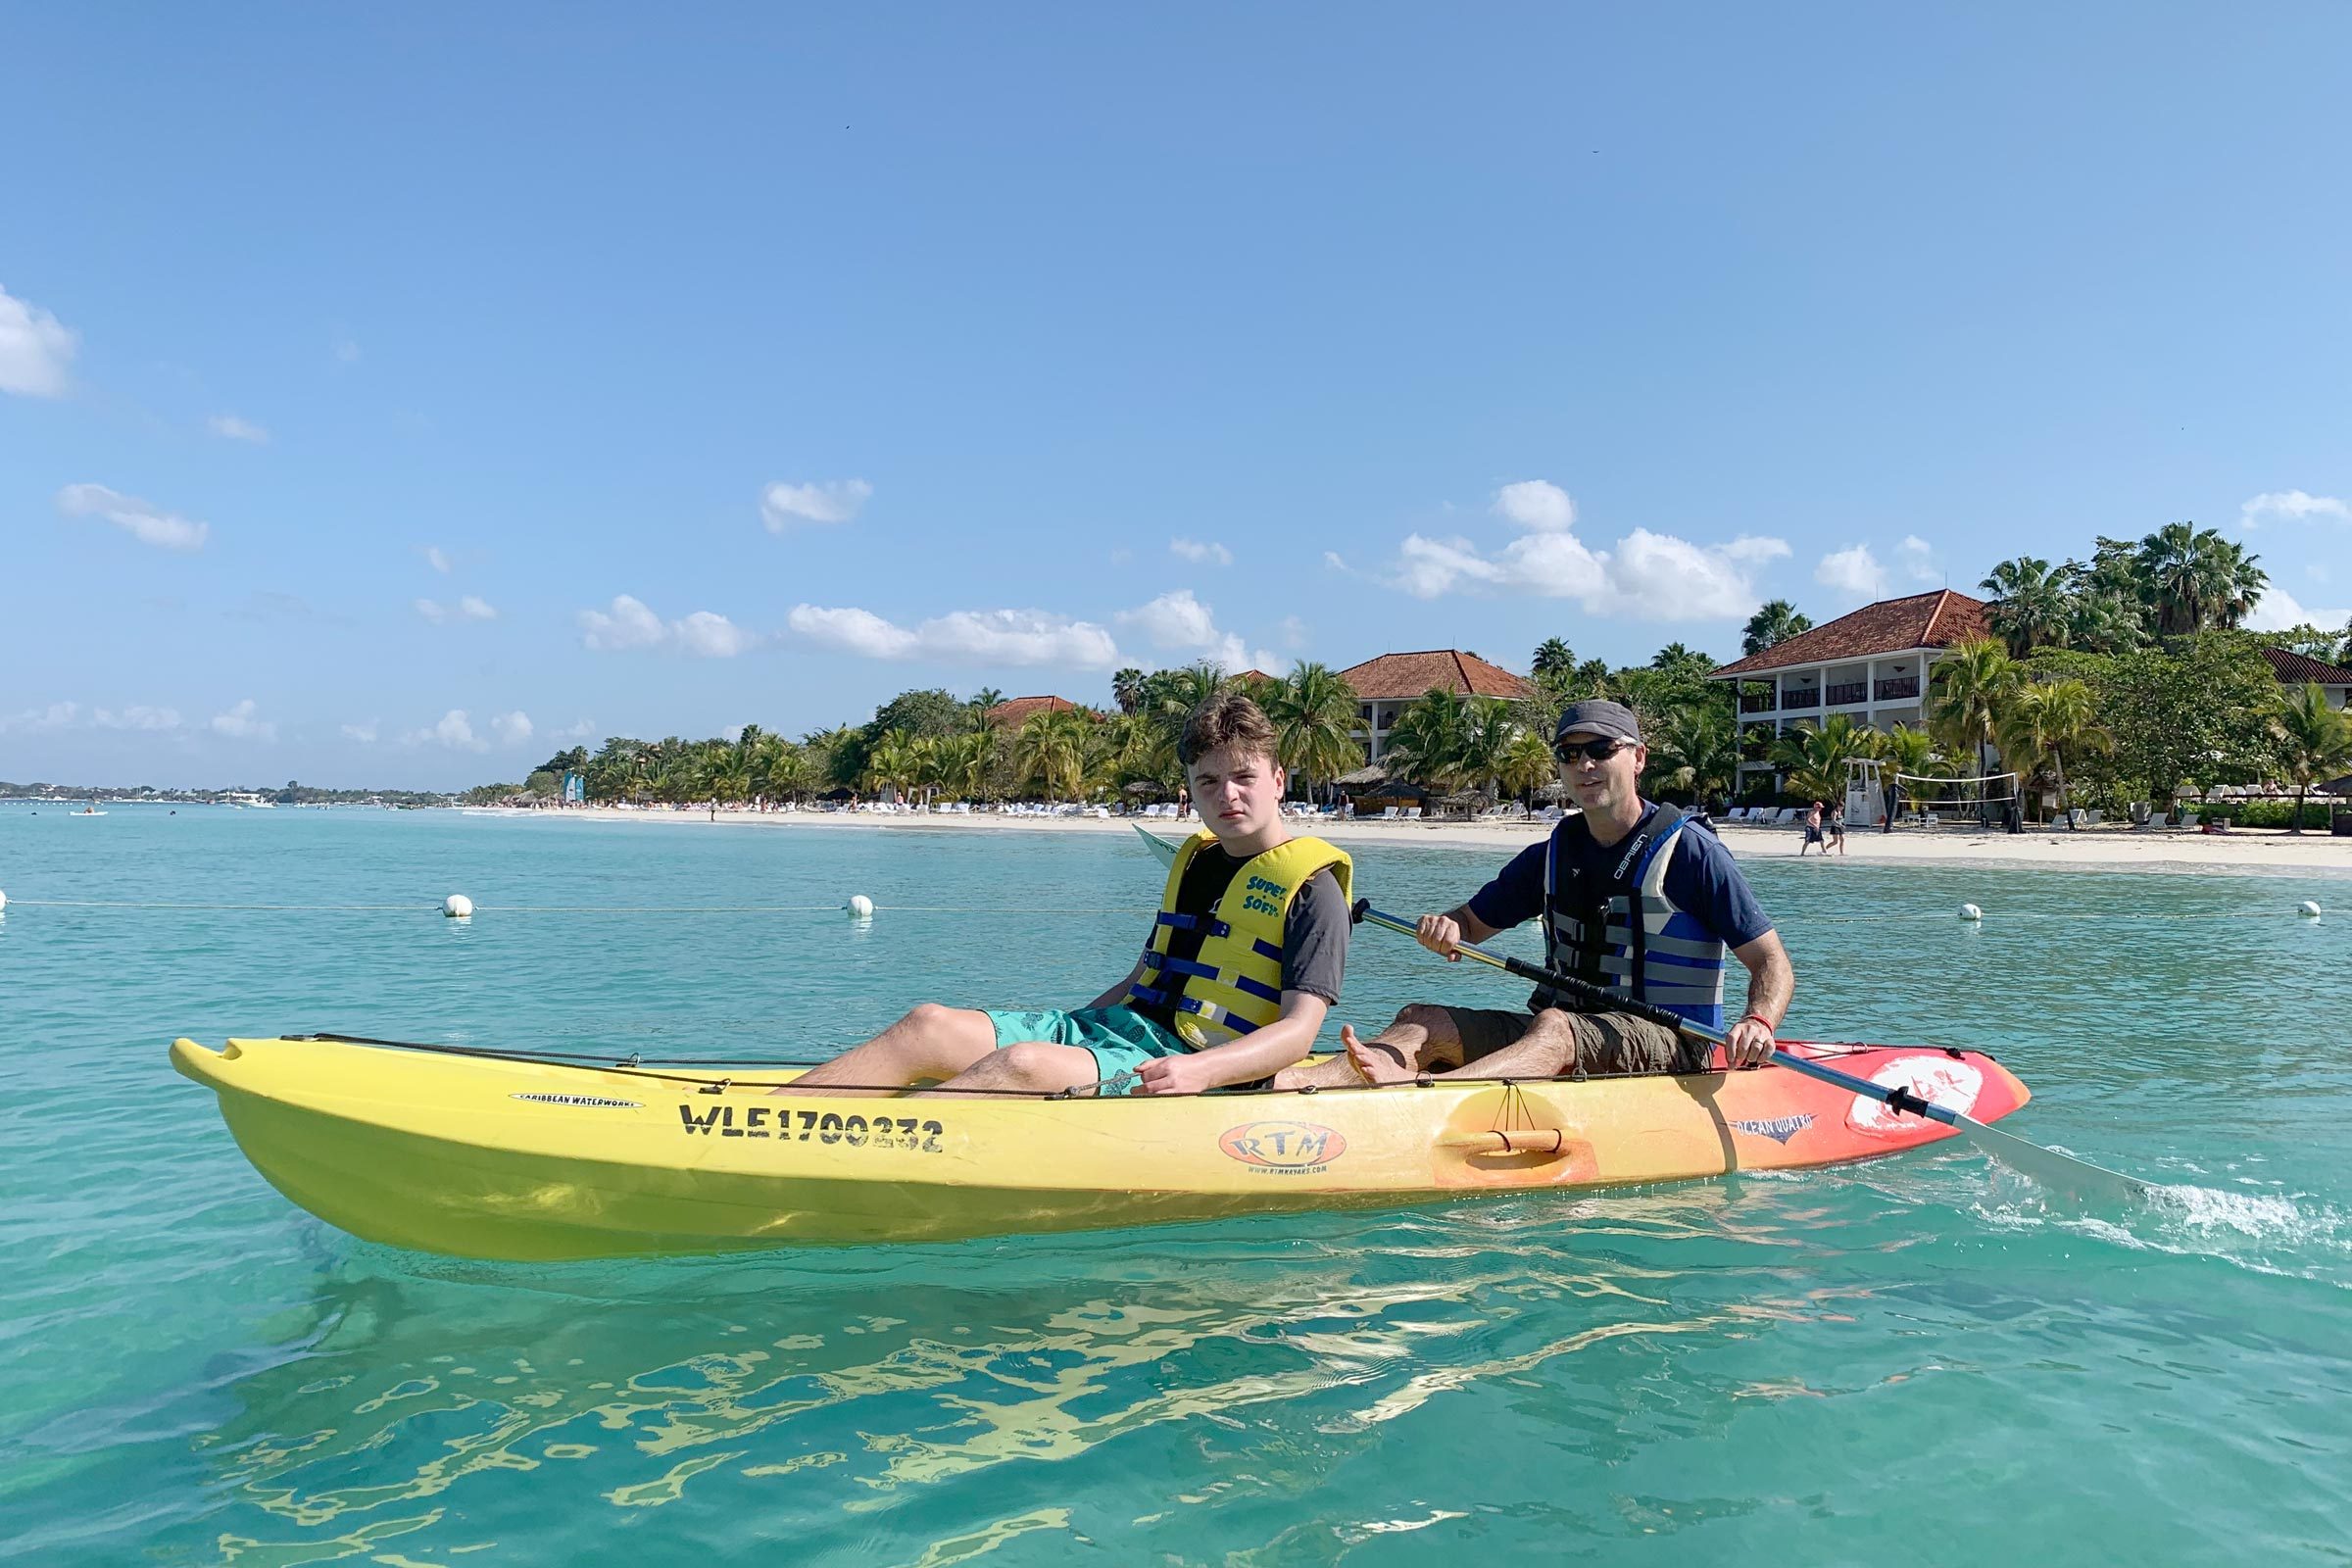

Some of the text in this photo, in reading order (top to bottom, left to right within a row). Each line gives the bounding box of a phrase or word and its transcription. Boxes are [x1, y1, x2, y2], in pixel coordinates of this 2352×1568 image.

[1613, 833, 1648, 880] OBRIEN
[519, 1094, 634, 1107] CARIBBEAN WATERWORKS
[678, 1103, 944, 1153] WLE1700232
[1737, 1113, 1813, 1137] OCEAN QUATRO
[1229, 1130, 1330, 1157] RTM
